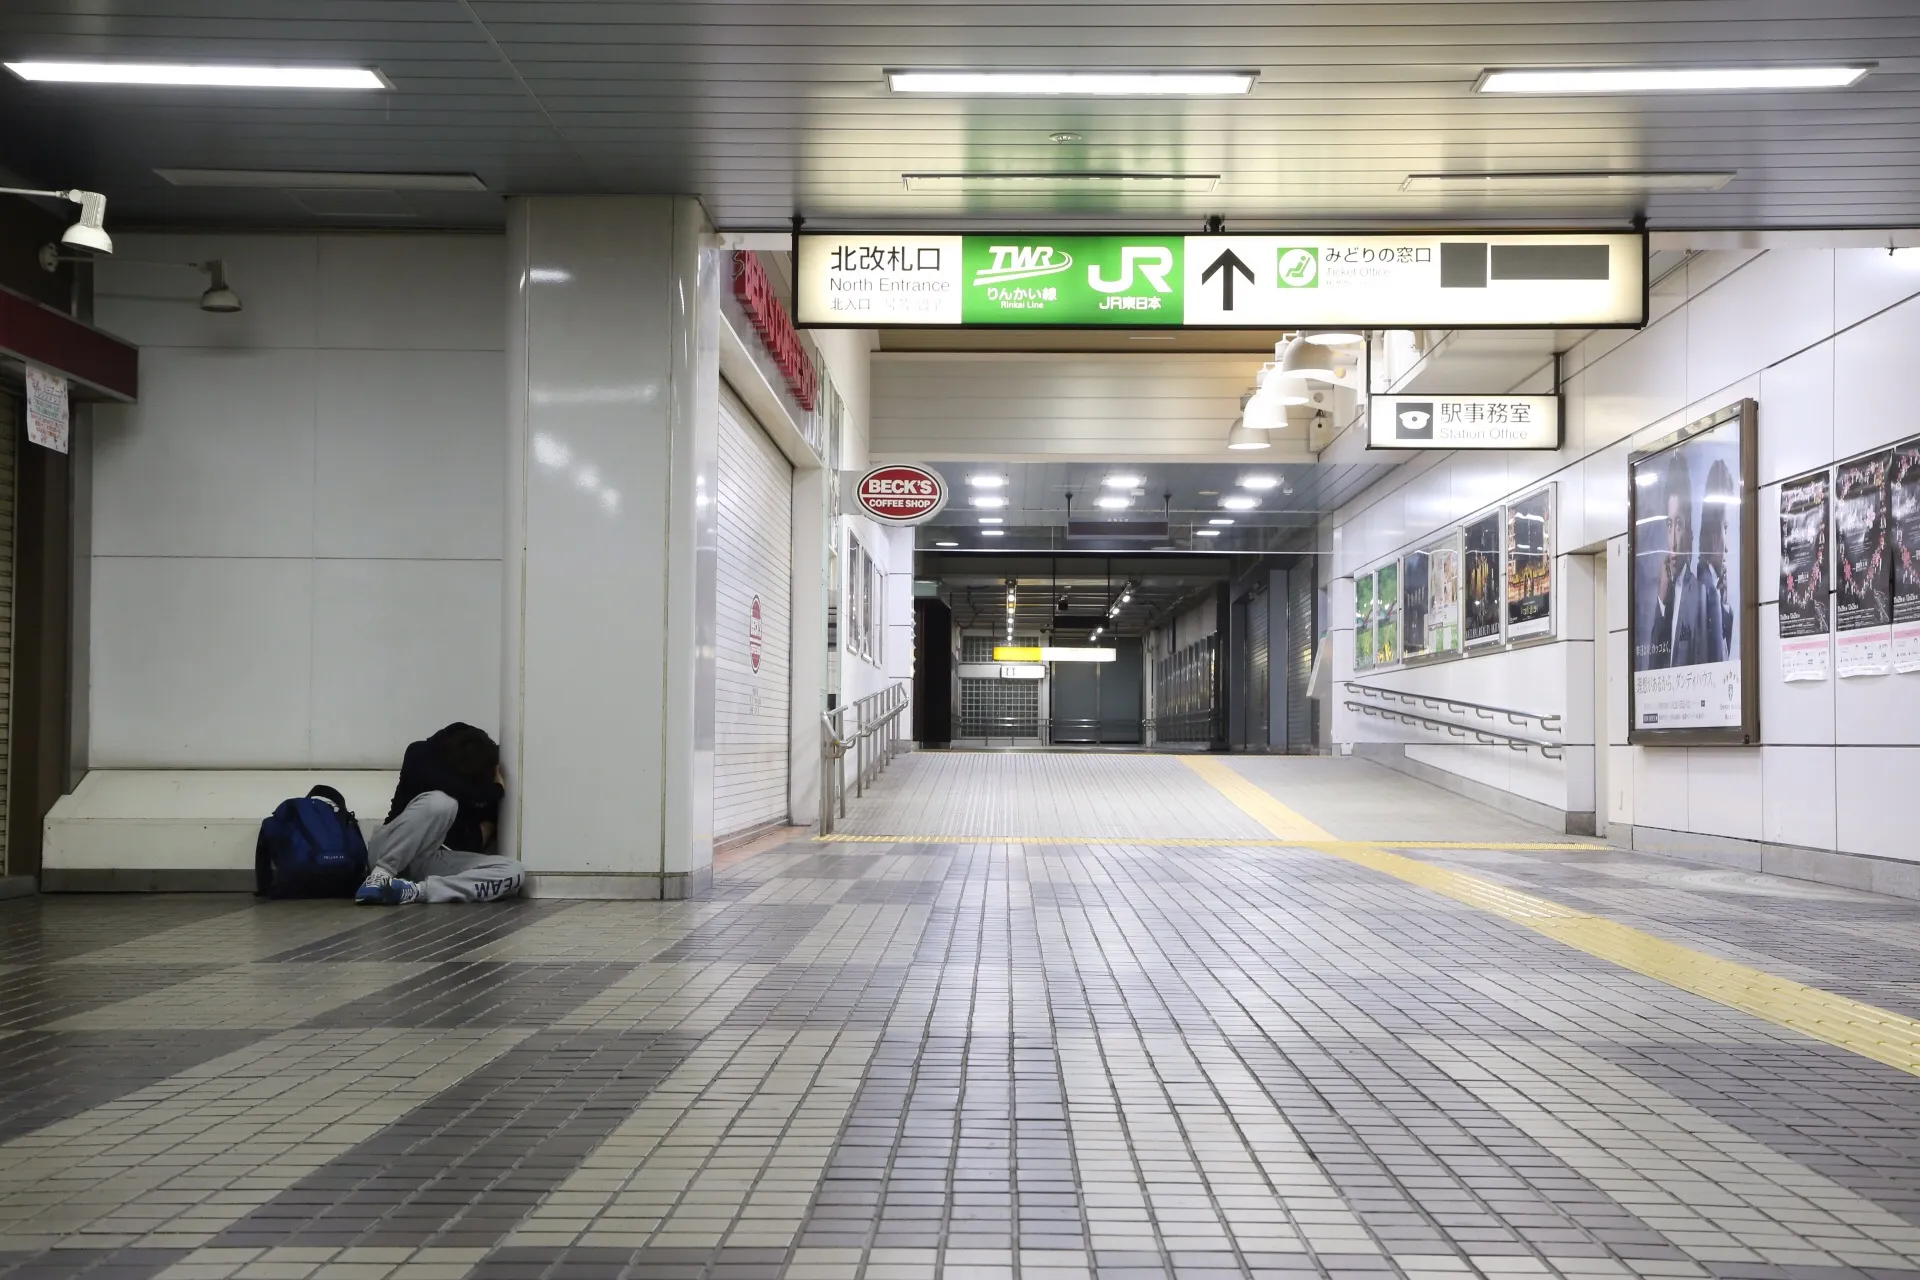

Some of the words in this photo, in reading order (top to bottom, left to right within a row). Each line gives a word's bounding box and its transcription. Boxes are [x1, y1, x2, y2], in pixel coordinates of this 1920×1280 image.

[831, 246, 940, 272] 北改札口
[988, 246, 1054, 270] TWR
[1325, 246, 1431, 263] みどりの窓口
[1088, 247, 1173, 293] JR
[830, 277, 873, 292] North
[879, 277, 950, 292] Entrance
[987, 287, 1057, 301] りんかい線
[831, 297, 870, 311] 北入口
[1001, 300, 1025, 309] Rinkai
[1027, 301, 1044, 309] Line
[1099, 296, 1162, 310] JR東日本
[1441, 402, 1531, 423] 駅事務室
[1440, 427, 1485, 440] Station
[1489, 427, 1528, 440] Office
[868, 479, 932, 495] BECK'S
[869, 499, 904, 508] COFFEE
[905, 499, 931, 508] SHOP
[474, 873, 521, 899] TEAM
